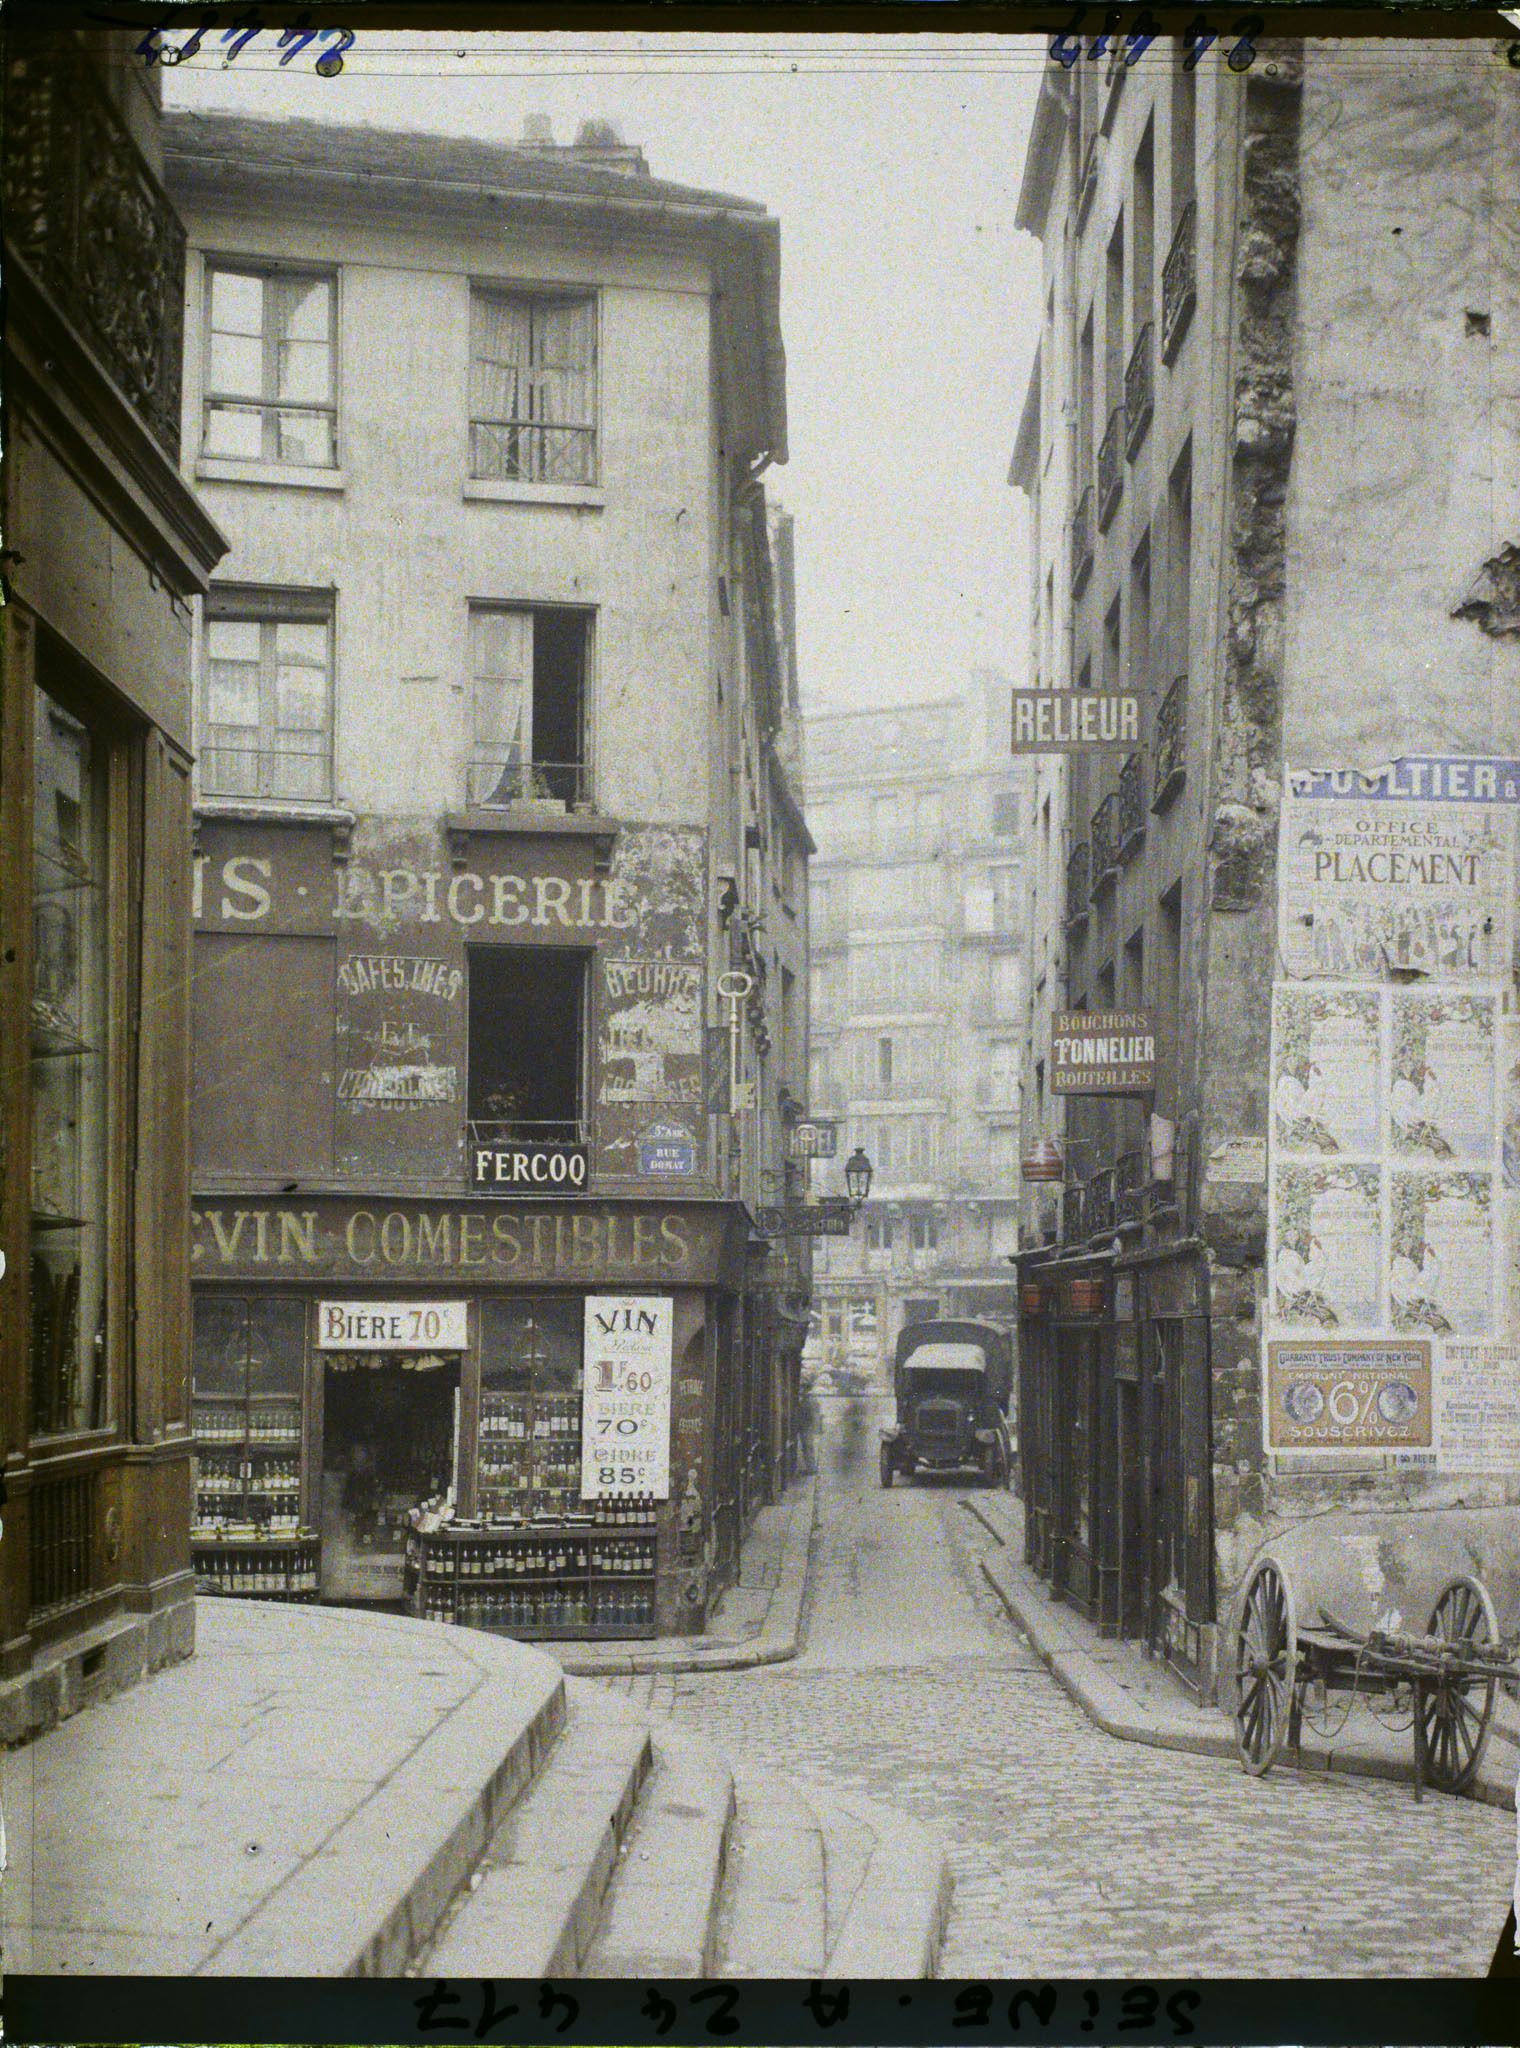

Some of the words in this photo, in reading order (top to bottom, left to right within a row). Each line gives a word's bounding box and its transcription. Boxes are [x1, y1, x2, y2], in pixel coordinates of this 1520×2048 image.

[1016, 697, 1138, 741] RELIEUR
[1356, 821, 1439, 835] OFFICE
[1335, 834, 1460, 848] DEPARTEMENTAL
[1313, 851, 1480, 885] PLACEMENT
[332, 867, 637, 928] EPICERIE
[1059, 1013, 1148, 1032] BOUCHONS
[1054, 1036, 1155, 1065] TONNELIER
[1056, 1070, 1152, 1087] BOUTEILLES
[657, 1148, 680, 1158] RUE
[476, 1150, 586, 1186] FERCOQ
[651, 1160, 684, 1170] DOMAT
[347, 1211, 689, 1265] COMESTIBLES
[595, 1309, 658, 1336] VIN
[1353, 1372, 1411, 1380] NATIONAL
[1290, 1426, 1411, 1437] SOUSCRIVEZ
